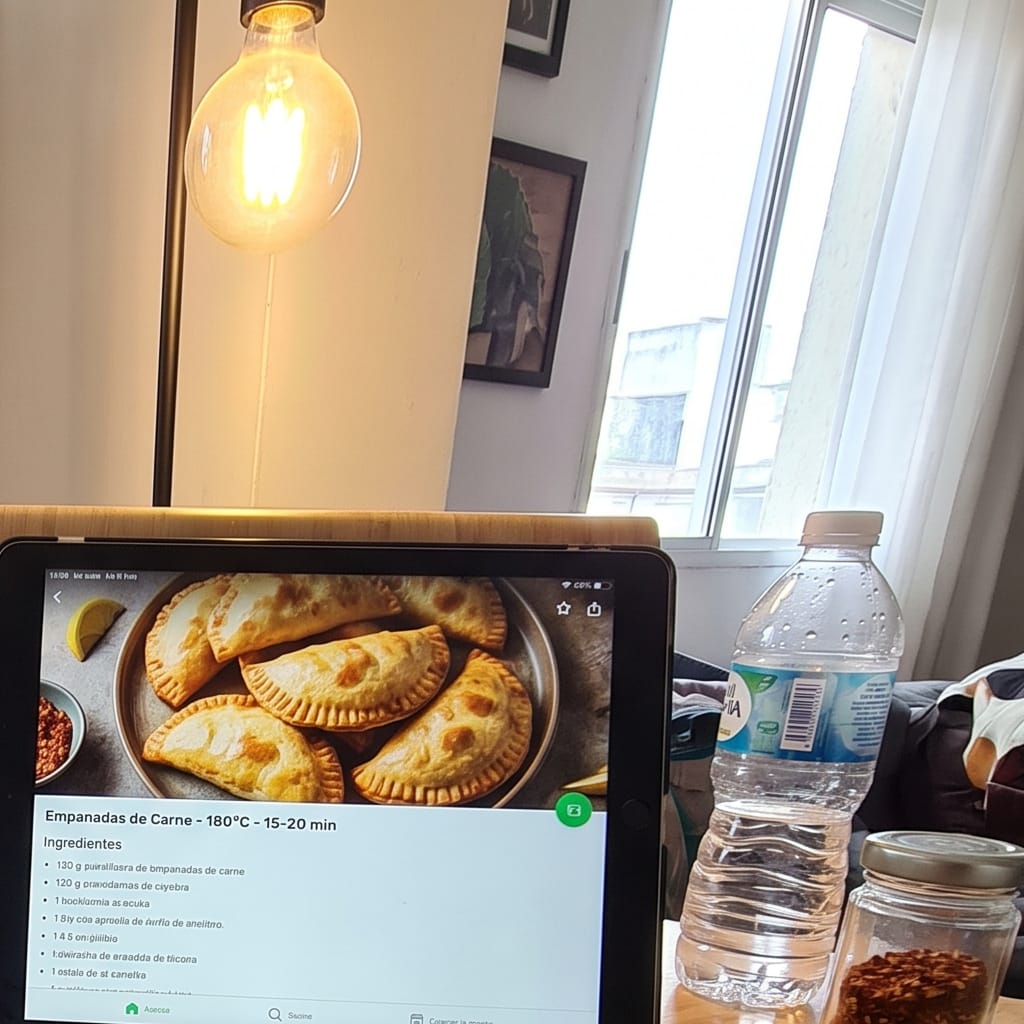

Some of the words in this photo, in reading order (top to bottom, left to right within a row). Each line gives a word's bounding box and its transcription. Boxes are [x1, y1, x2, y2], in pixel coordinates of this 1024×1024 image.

[45, 810, 126, 825] Empanadas
[129, 812, 147, 825] de
[151, 813, 193, 826] Carne
[263, 817, 306, 830] 15-20
[310, 819, 337, 831] min
[43, 836, 122, 852] Ingredientes
[57, 861, 73, 870] 130
[75, 863, 82, 872] g
[135, 863, 148, 873] de
[205, 866, 217, 875] de
[219, 868, 245, 877] carne
[55, 879, 72, 888] 120
[74, 881, 81, 890] g
[141, 881, 153, 890] de
[132, 917, 143, 926] de
[172, 919, 184, 928] de
[99, 951, 111, 960] de
[153, 953, 165, 962] de
[86, 968, 98, 977] de
